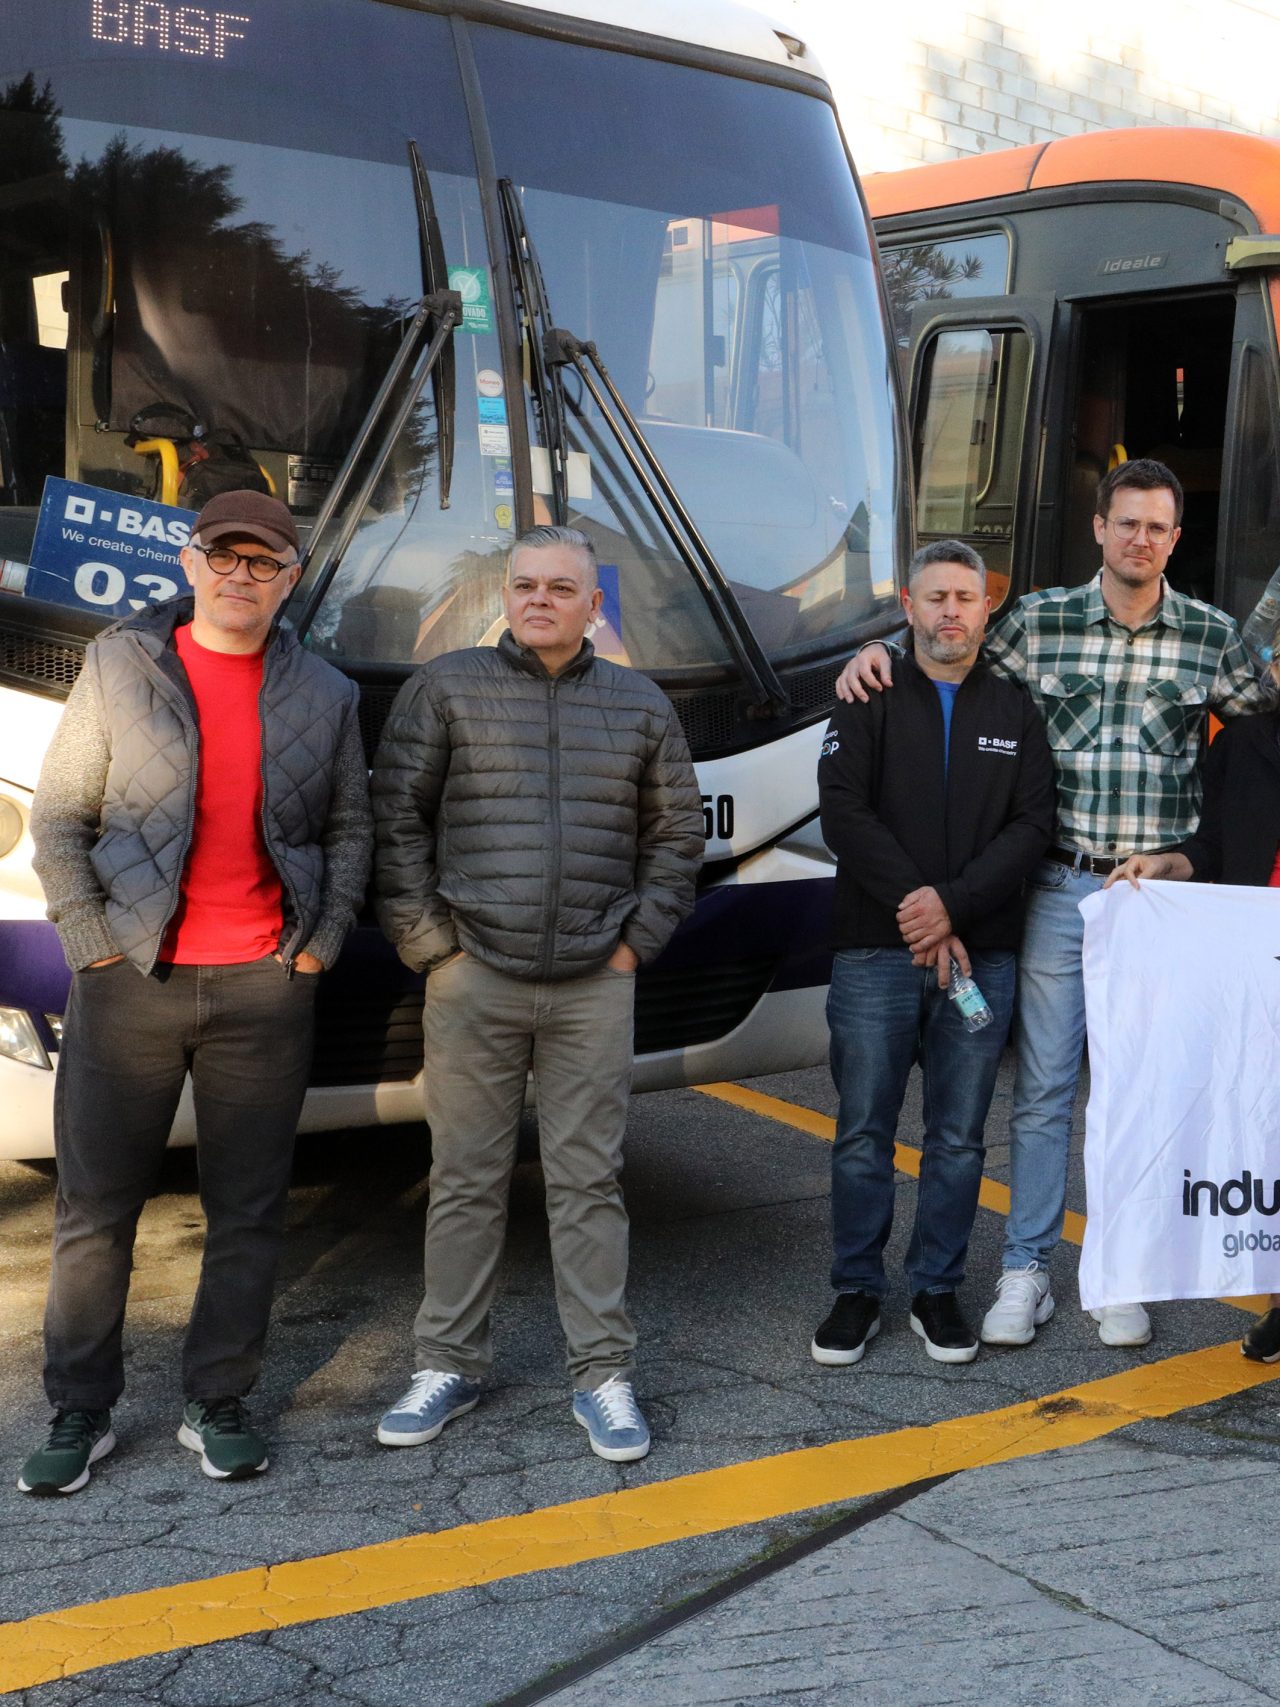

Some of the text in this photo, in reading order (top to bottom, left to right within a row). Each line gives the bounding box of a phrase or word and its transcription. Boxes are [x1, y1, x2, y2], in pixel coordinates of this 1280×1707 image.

[92, 0, 250, 58] BASF
[1103, 255, 1162, 272] Ideale
[61, 527, 182, 566] We create chemi
[116, 507, 191, 547] BAS
[74, 561, 179, 611] 03
[992, 738, 1018, 750] BASF
